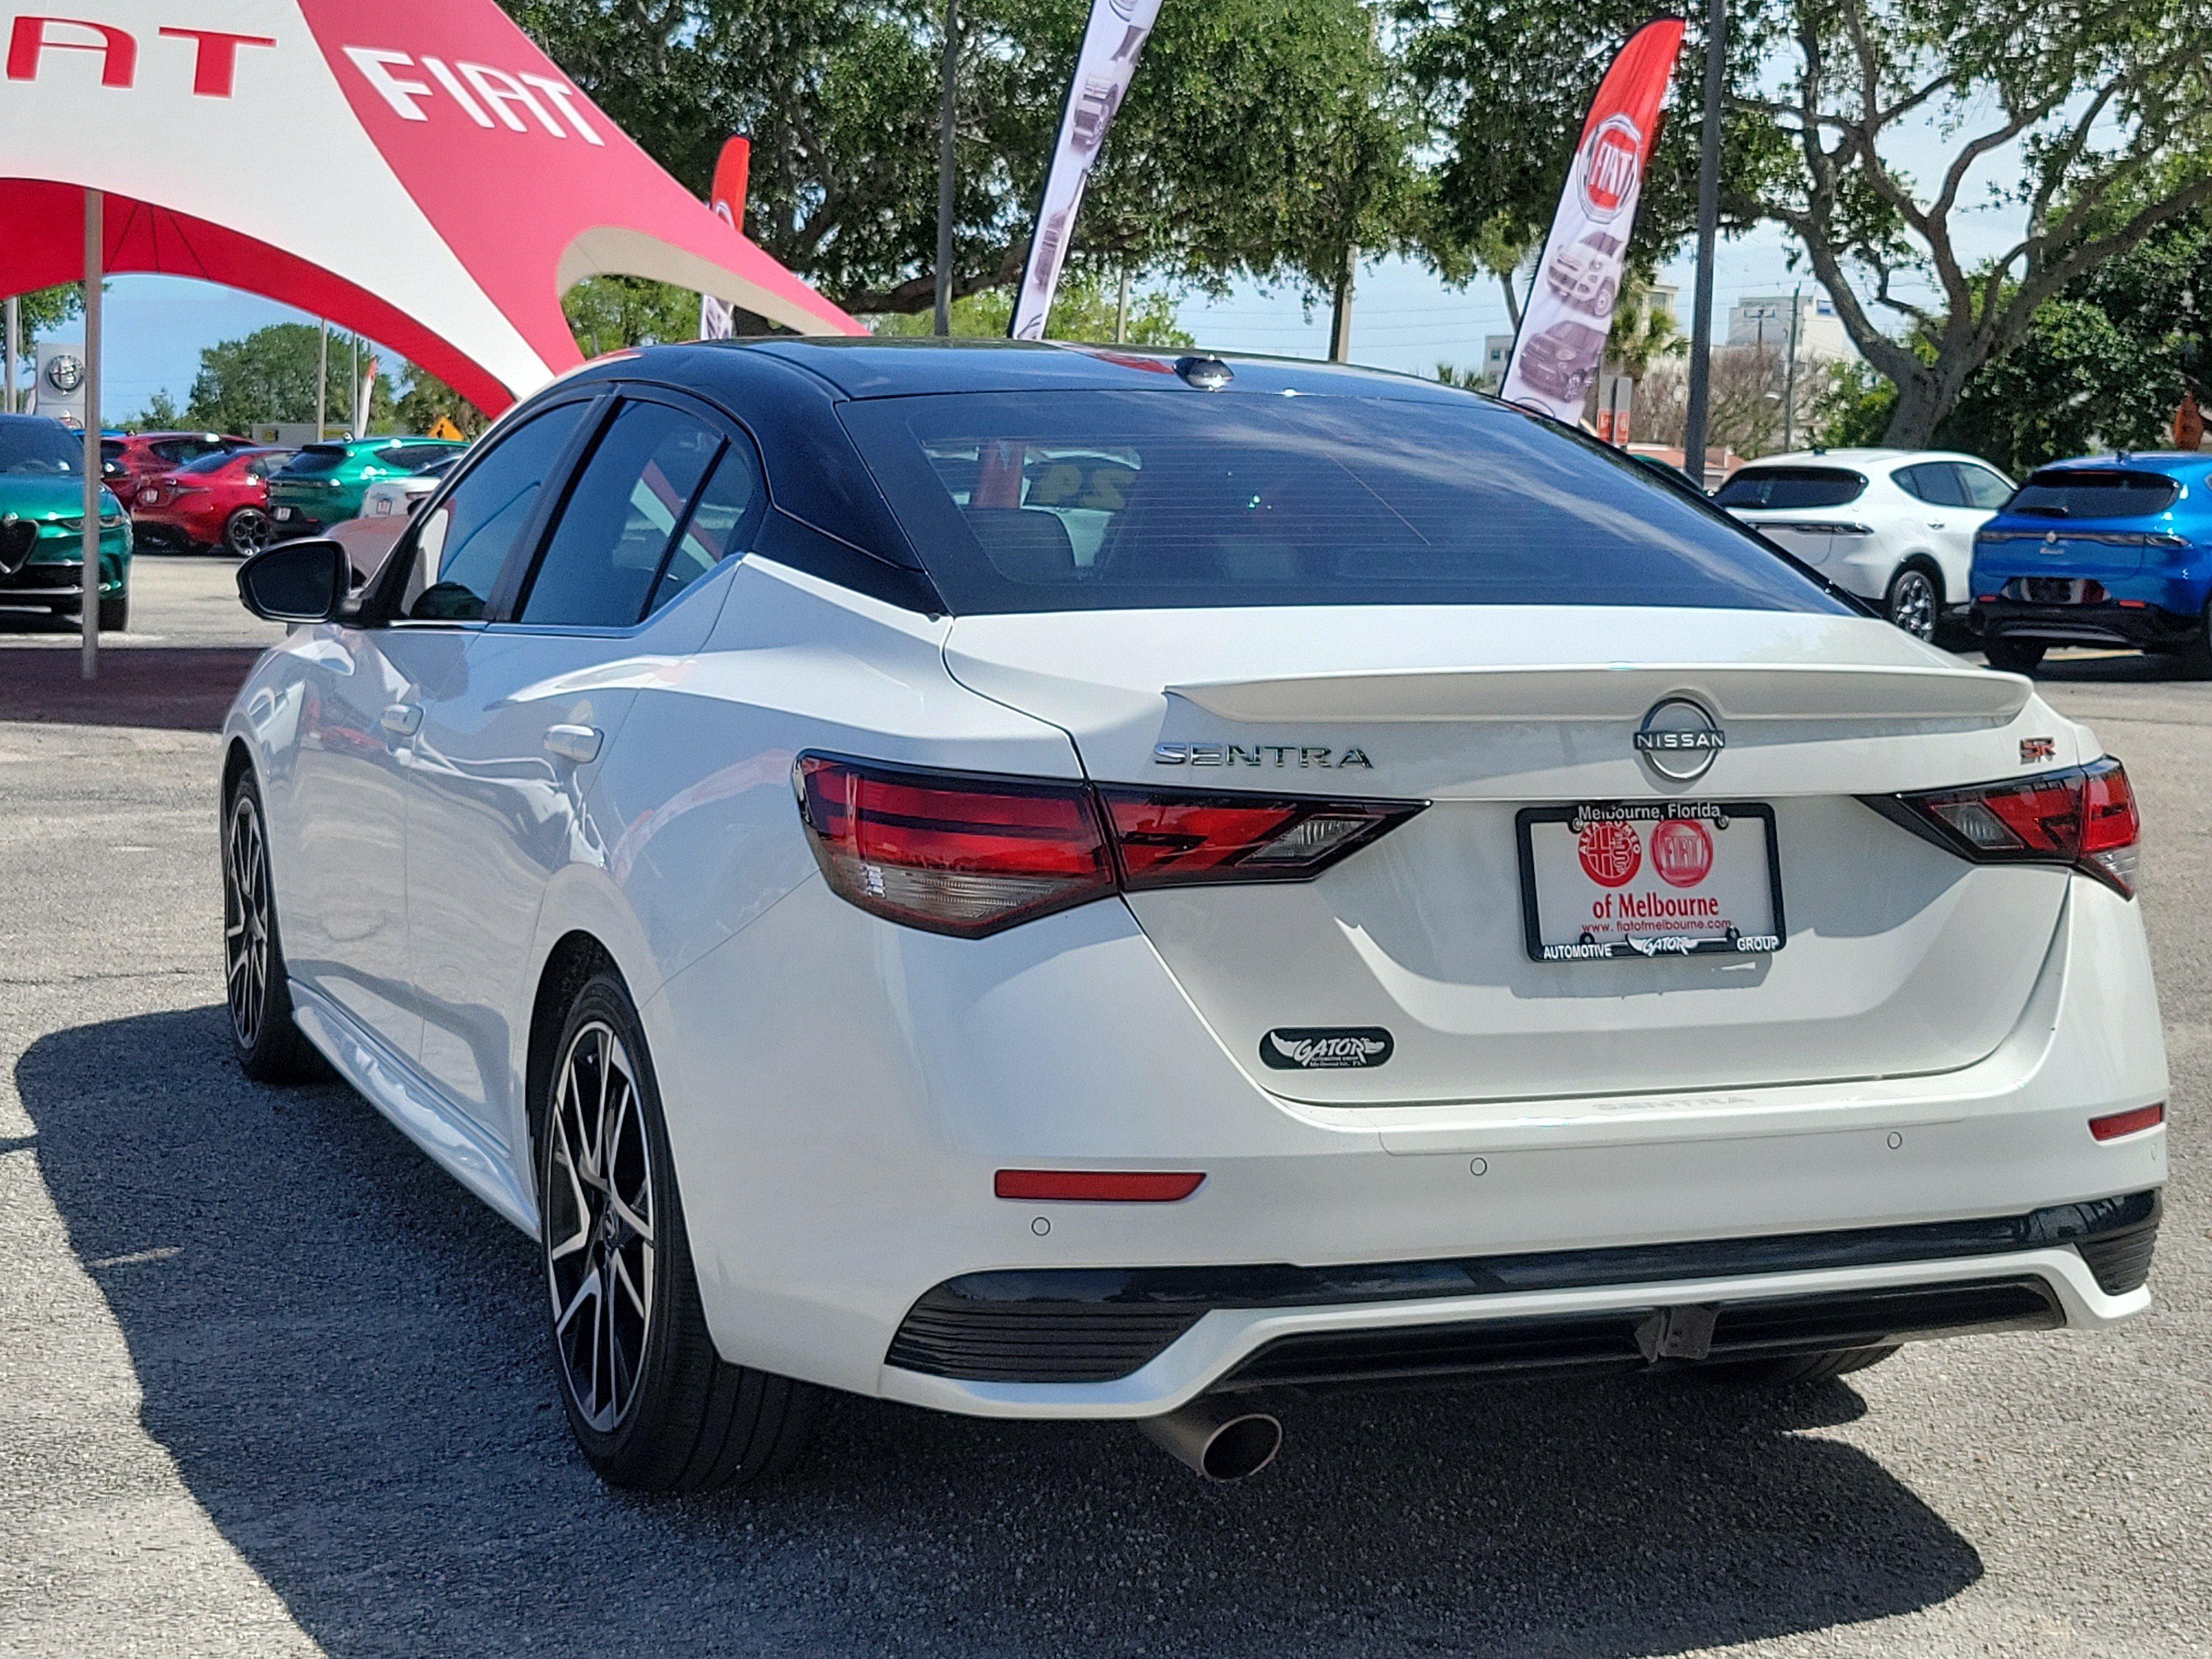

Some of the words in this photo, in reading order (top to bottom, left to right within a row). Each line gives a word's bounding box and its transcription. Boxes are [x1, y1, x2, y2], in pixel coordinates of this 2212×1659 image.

[7, 15, 278, 99] AT
[342, 46, 605, 147] FIAT
[1591, 141, 1633, 196] FIAT
[1637, 732, 1724, 748] NISSAN
[2020, 737, 2056, 760] SR
[1154, 742, 1374, 769] SENTRA
[1668, 803, 1720, 818] Florida
[1660, 837, 1702, 869] FIAT
[1592, 893, 1612, 919] of
[1618, 892, 1719, 918] Melbourne
[1543, 944, 1612, 960] AUTOMOTIVE
[1643, 936, 1690, 957] GATOR
[1736, 935, 1779, 951] GROUP
[1293, 1037, 1367, 1067] GATOR
